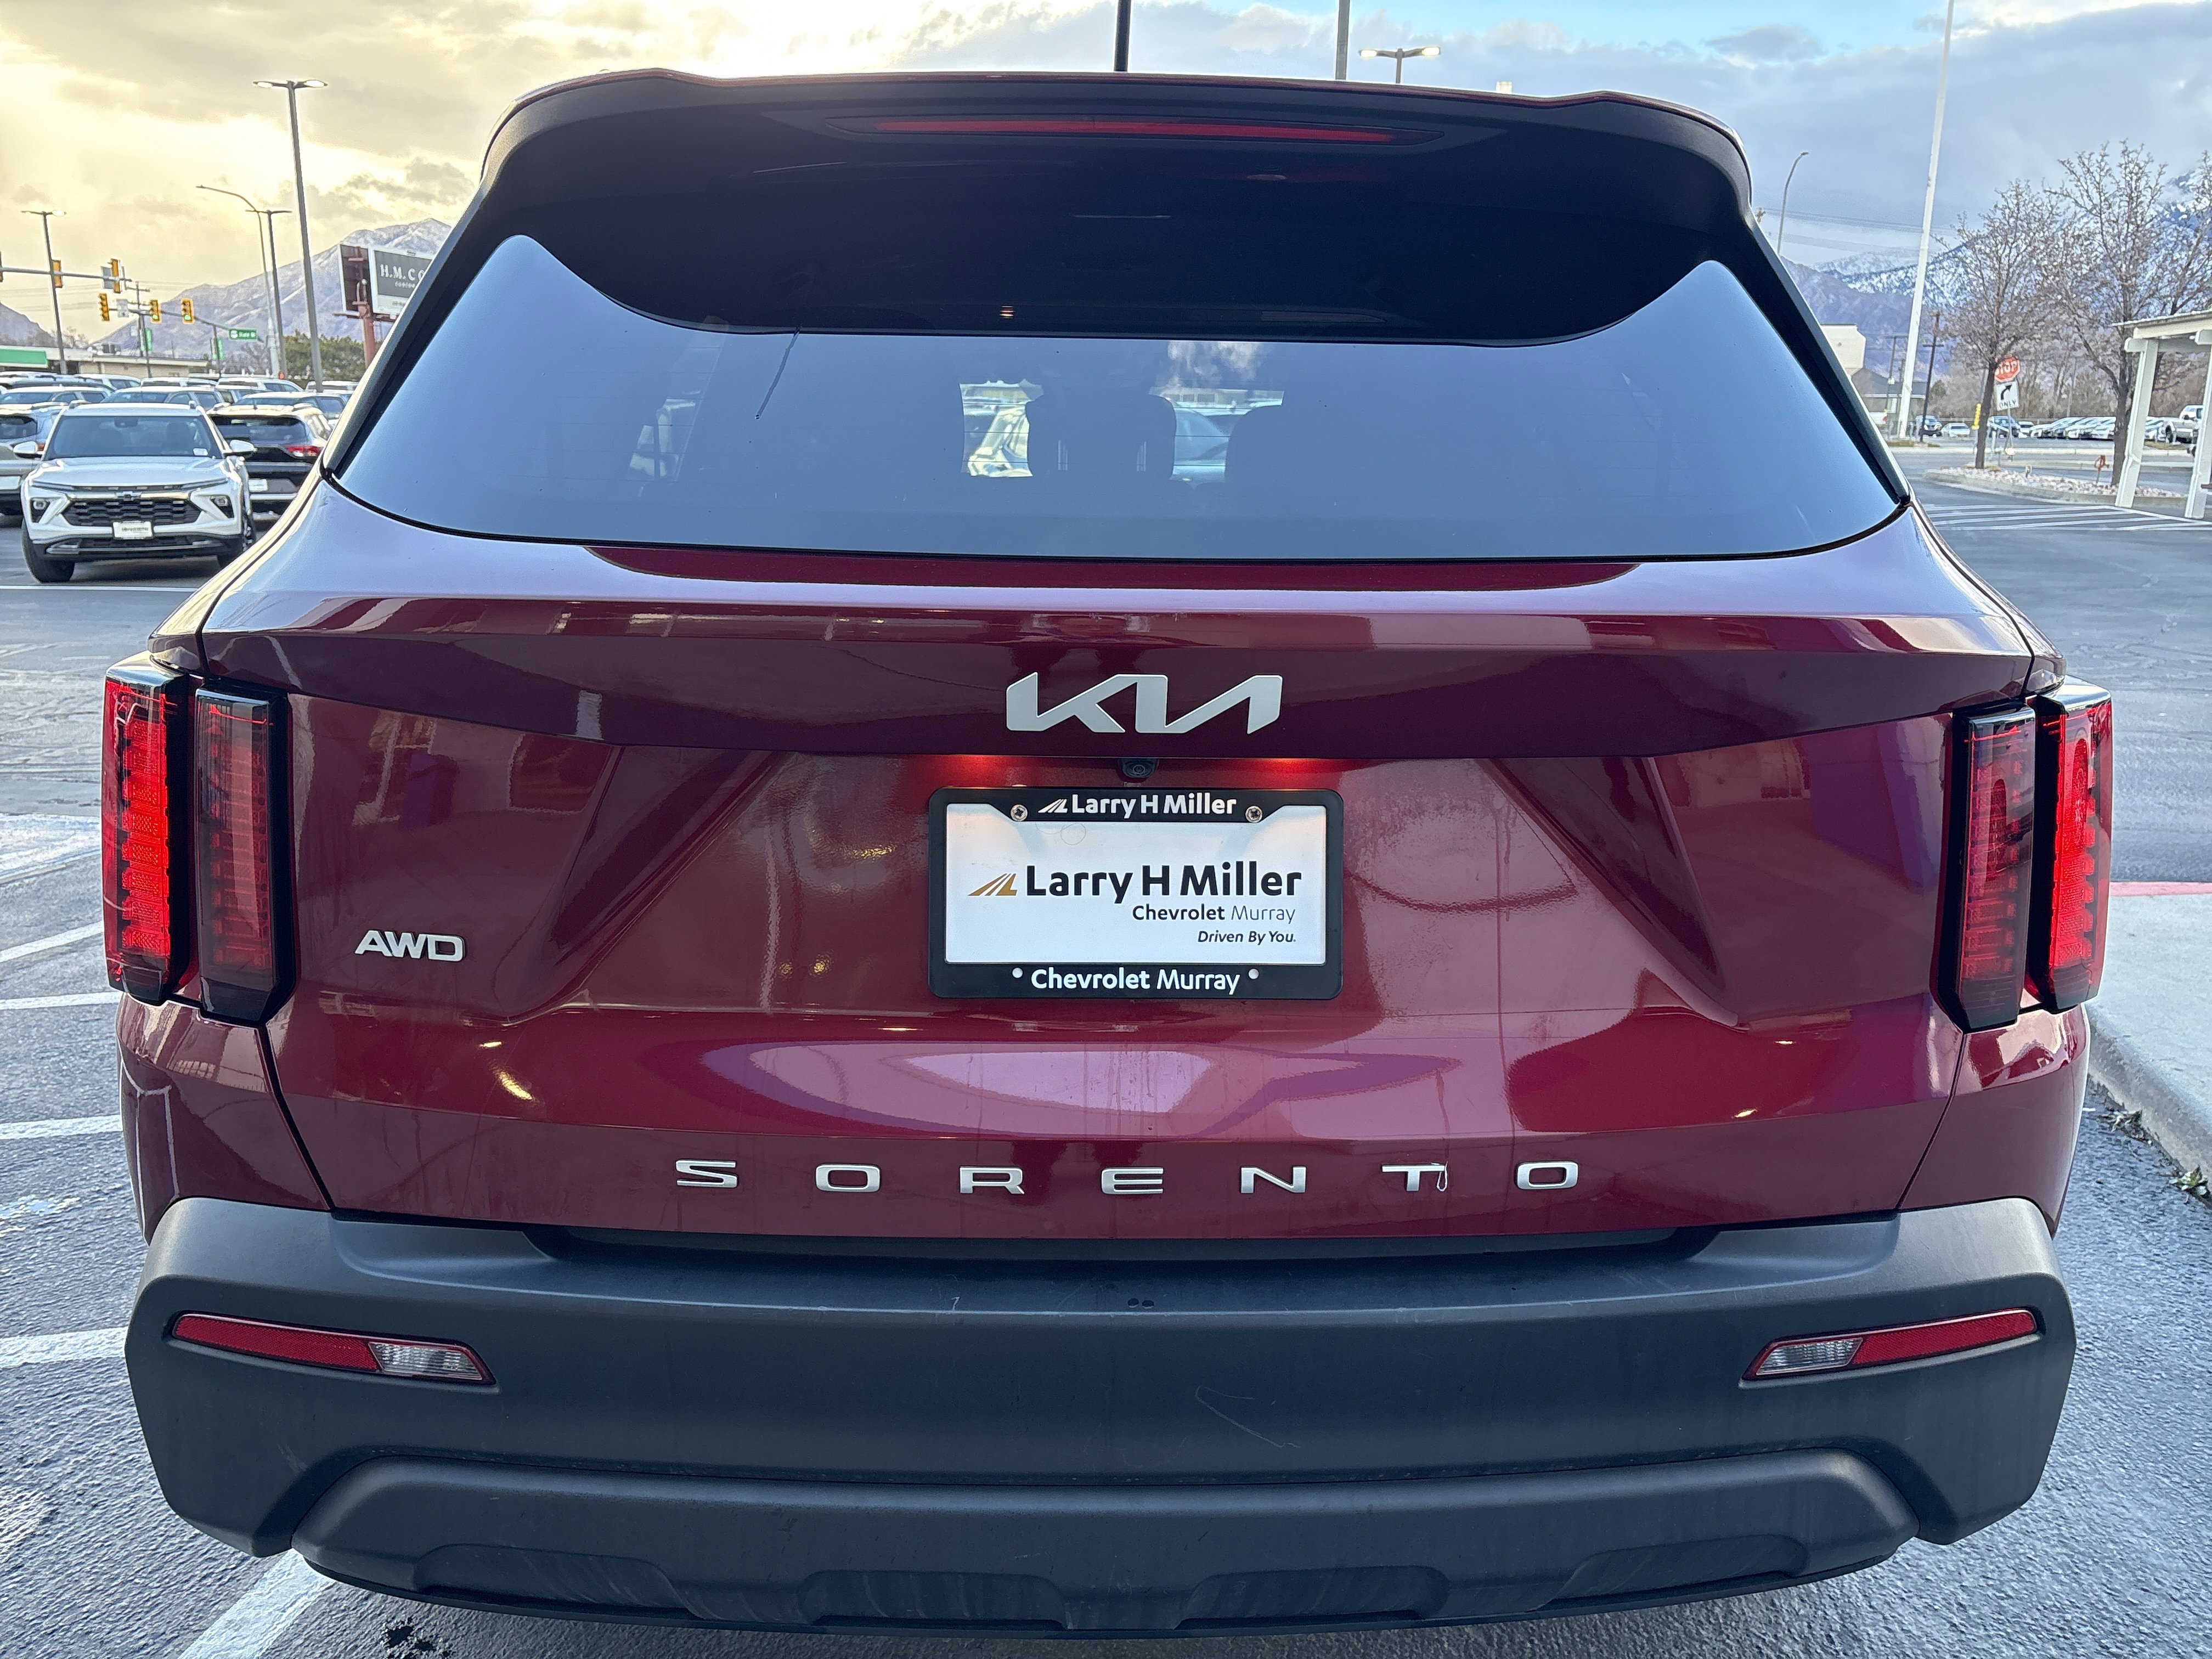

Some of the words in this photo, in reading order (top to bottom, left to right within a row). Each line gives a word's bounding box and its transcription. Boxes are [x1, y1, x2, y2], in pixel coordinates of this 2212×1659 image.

[1999, 399, 2017, 408] ONLY
[1006, 672, 1283, 734] KIA
[1072, 794, 1137, 819] Larry
[1141, 794, 1159, 814] H
[1163, 793, 1237, 814] Miller
[1026, 865, 1133, 904] Larry
[1142, 865, 1170, 896] H
[1180, 861, 1302, 896] Miller
[1132, 904, 1225, 921] Chevrolet
[1231, 905, 1296, 924] Murray
[354, 930, 465, 962] AWD
[1198, 930, 1243, 943] Driven
[1248, 930, 1266, 946] By
[1268, 930, 1296, 943] You.
[1031, 967, 1151, 989] Chevrolet
[1156, 969, 1240, 995] Murray
[675, 1159, 1579, 1194] SORENTO
